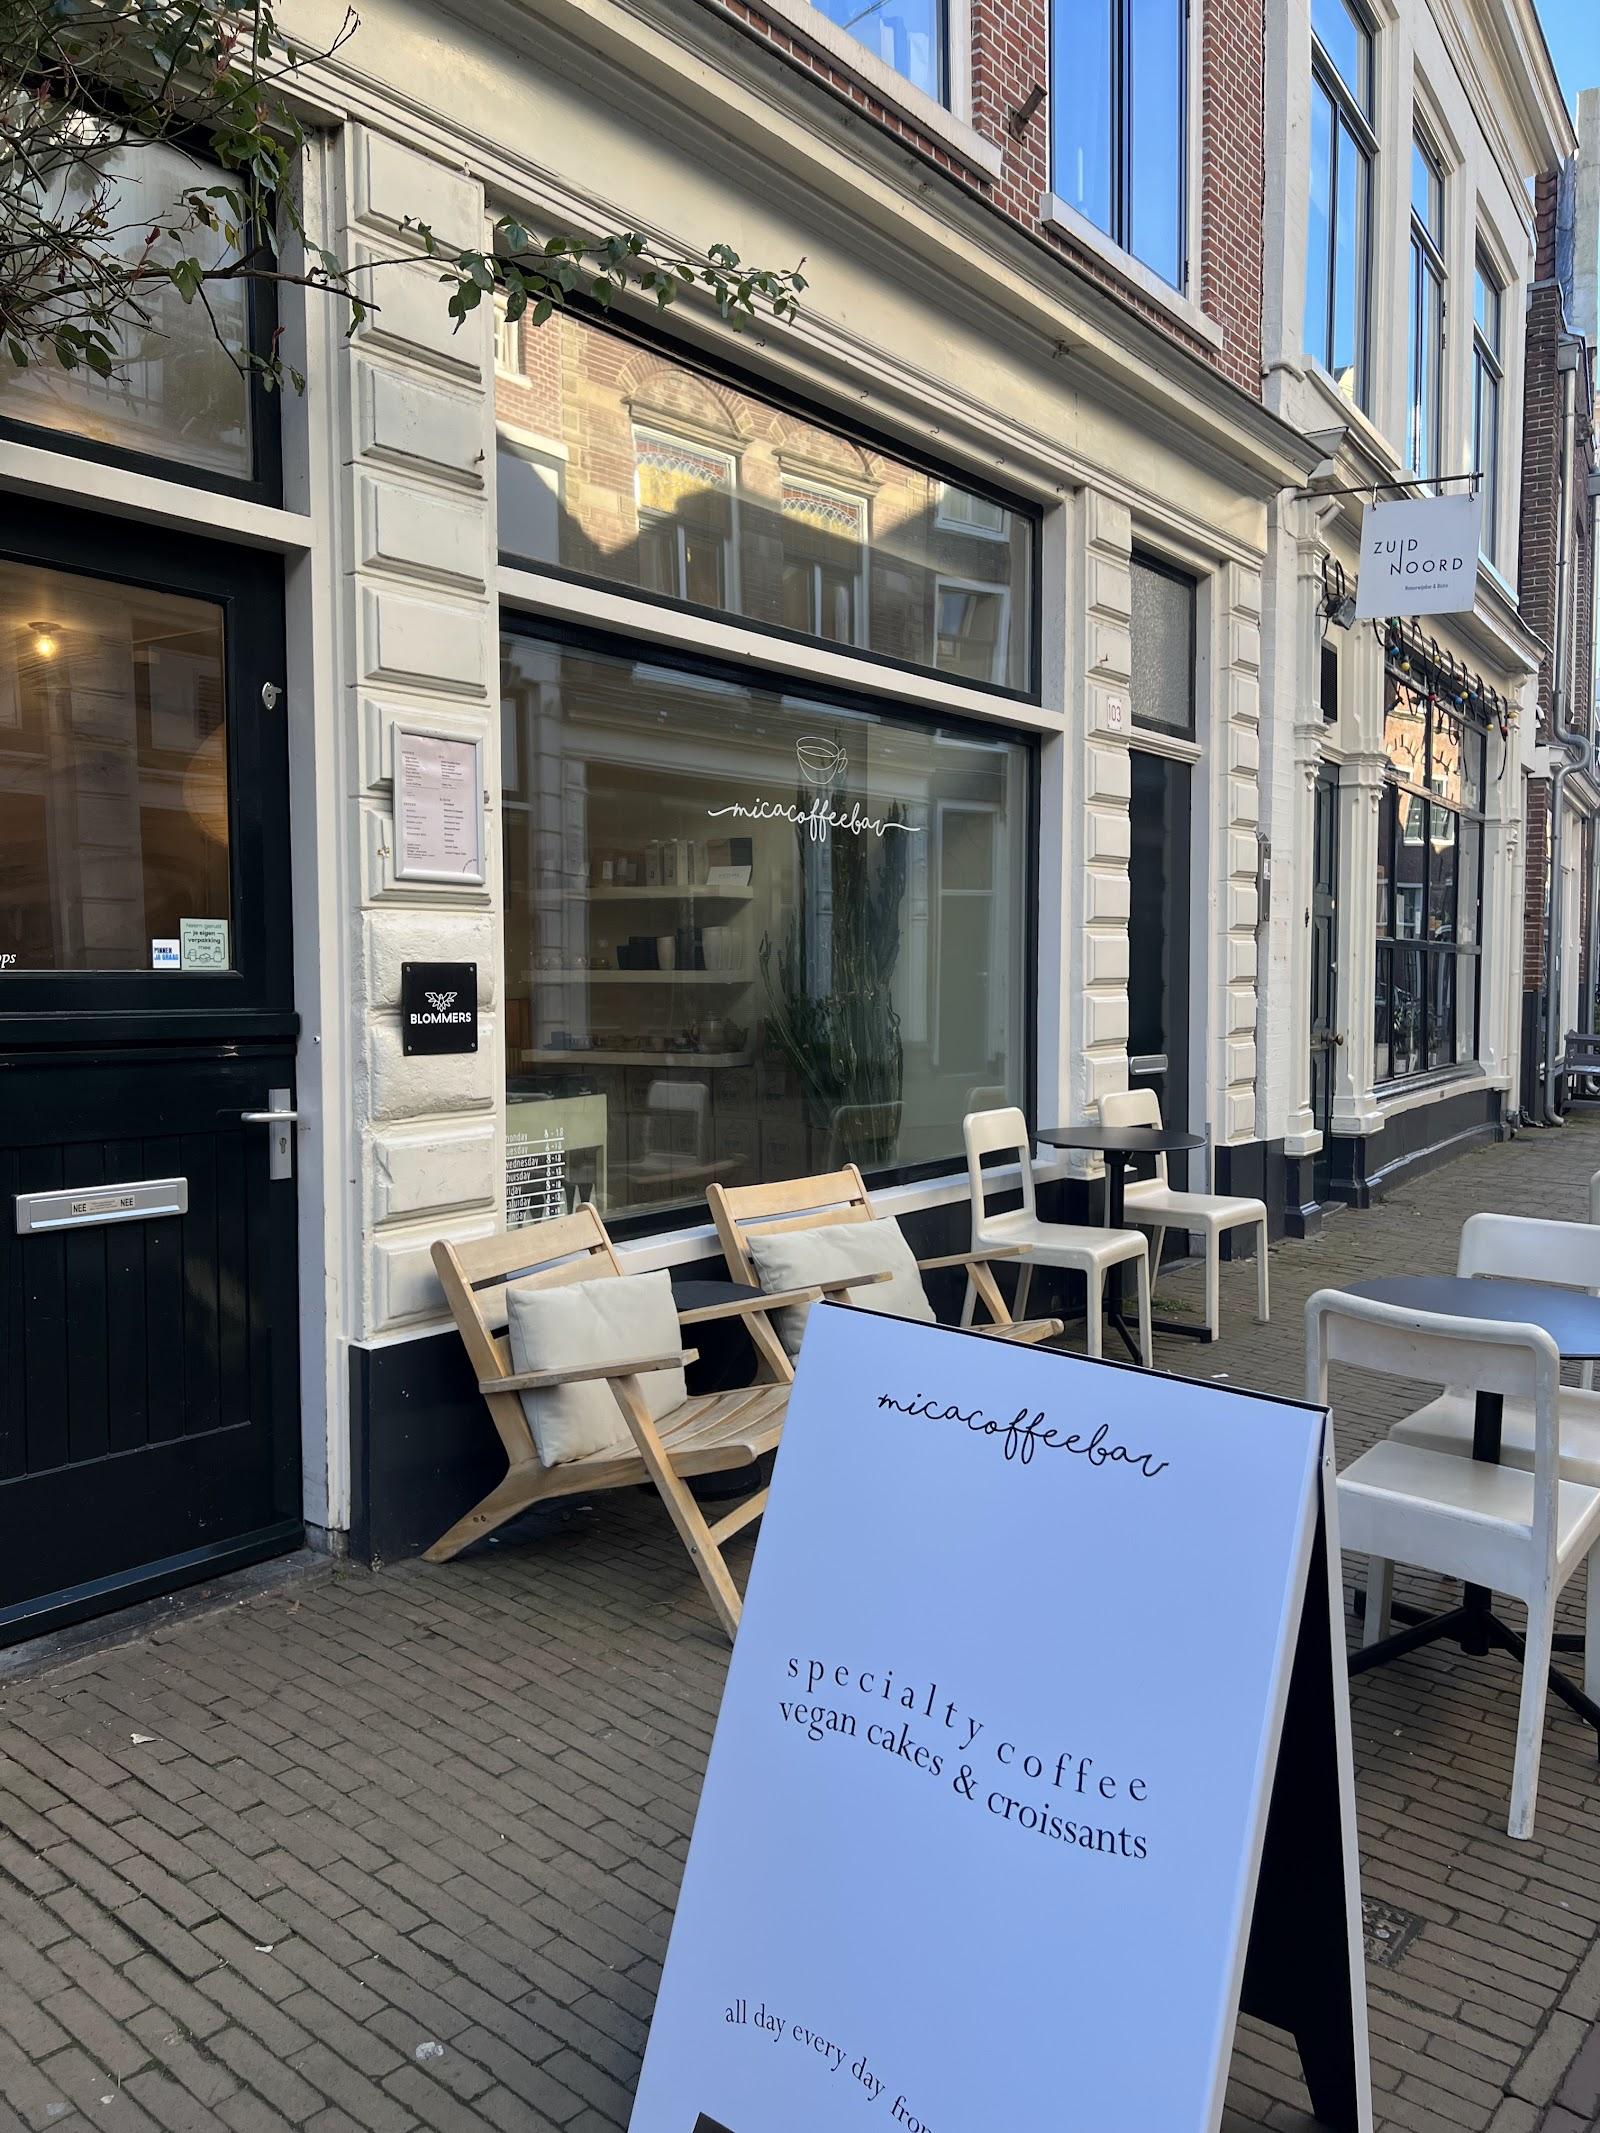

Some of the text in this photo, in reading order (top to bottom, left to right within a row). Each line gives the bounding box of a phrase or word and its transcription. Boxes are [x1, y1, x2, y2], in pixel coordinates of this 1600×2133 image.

[1374, 539, 1418, 554] ZUID
[1390, 558, 1463, 575] NOORD
[1108, 703, 1121, 722] 103
[410, 1012, 472, 1025] BLOMMERS
[73, 1203, 87, 1212] NEE
[120, 1198, 133, 1207] NEE
[878, 1393, 1169, 1477] micacoffeebar
[787, 1655, 1149, 1802] specialty coffee
[778, 1699, 1148, 1859] vegan cakes & croissants
[725, 1999, 932, 2133] all day every day fro
